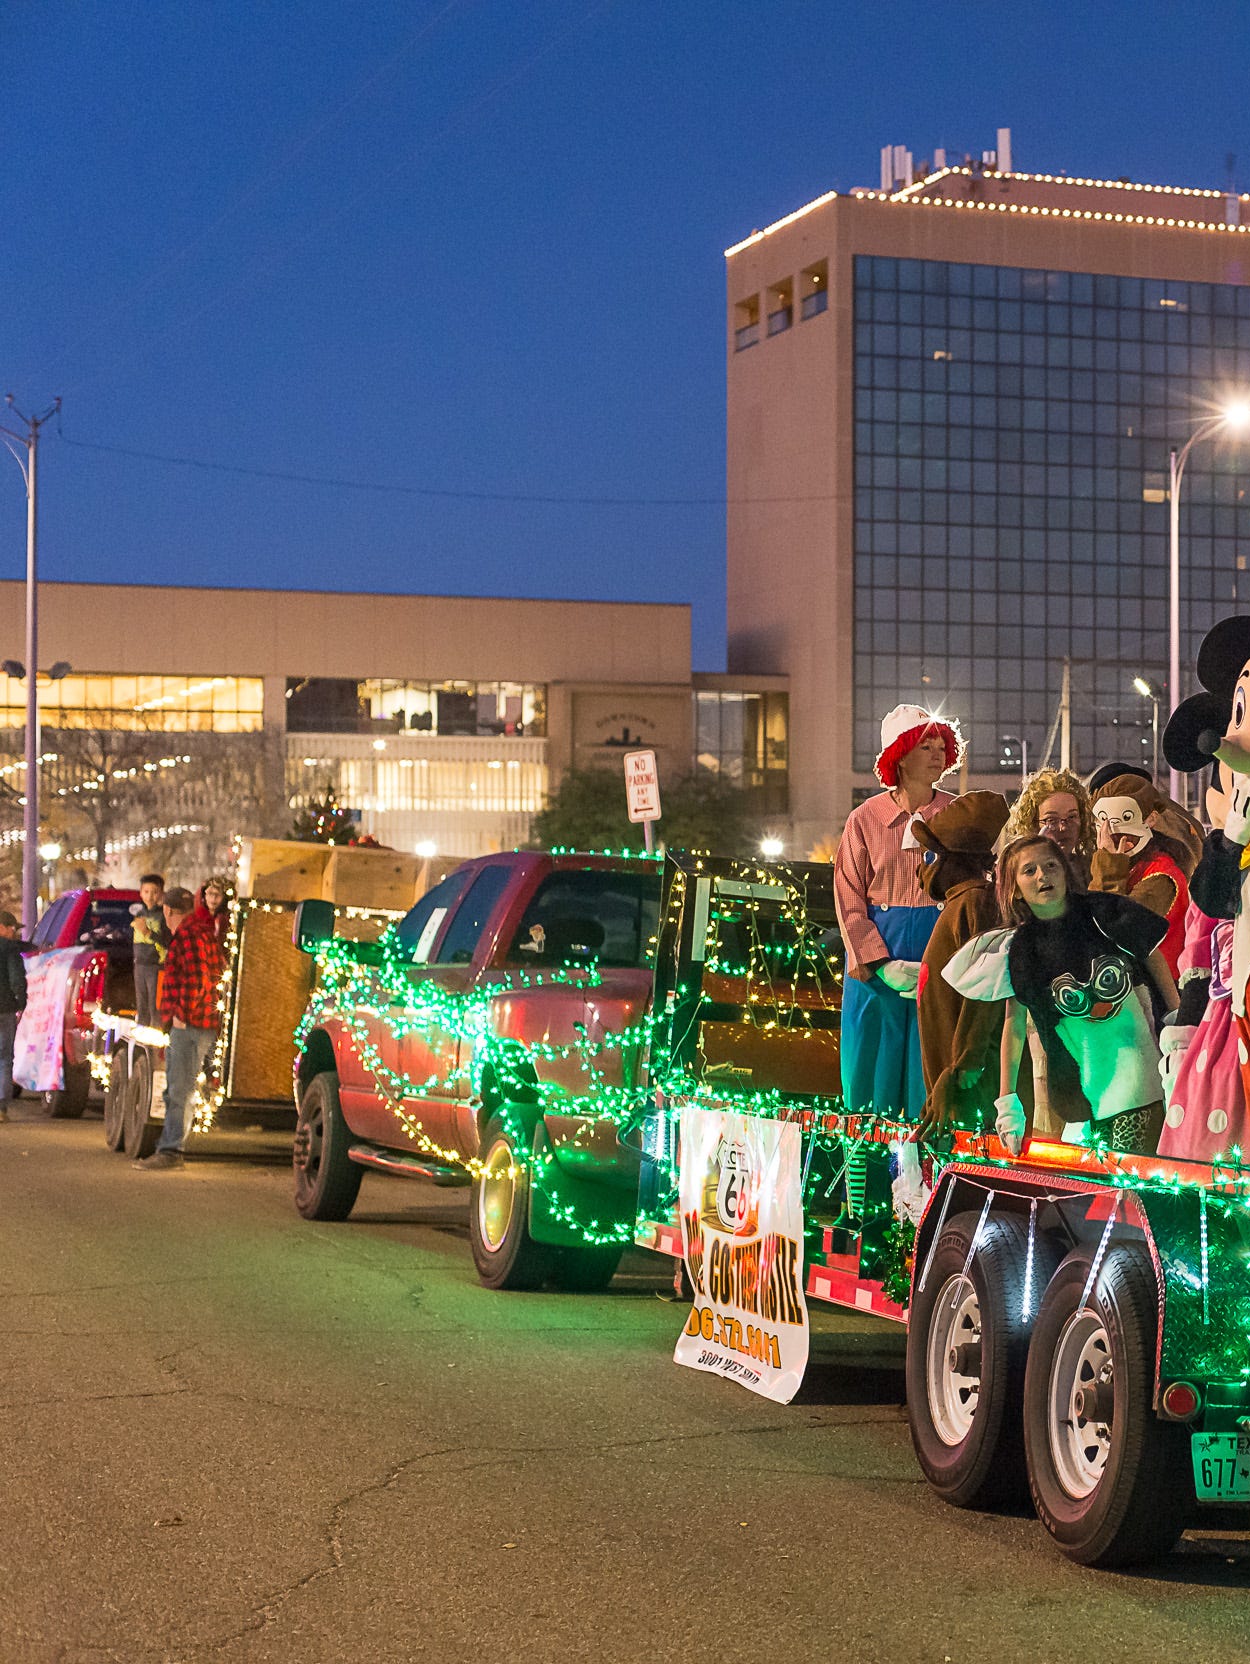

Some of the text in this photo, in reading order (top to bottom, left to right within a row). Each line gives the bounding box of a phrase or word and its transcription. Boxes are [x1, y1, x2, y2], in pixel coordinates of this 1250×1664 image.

[634, 759, 646, 771] NO
[628, 773, 655, 787] PARKING
[637, 787, 648, 796] ANY
[725, 1173, 747, 1221] 66
[1201, 1458, 1237, 1489] 677
